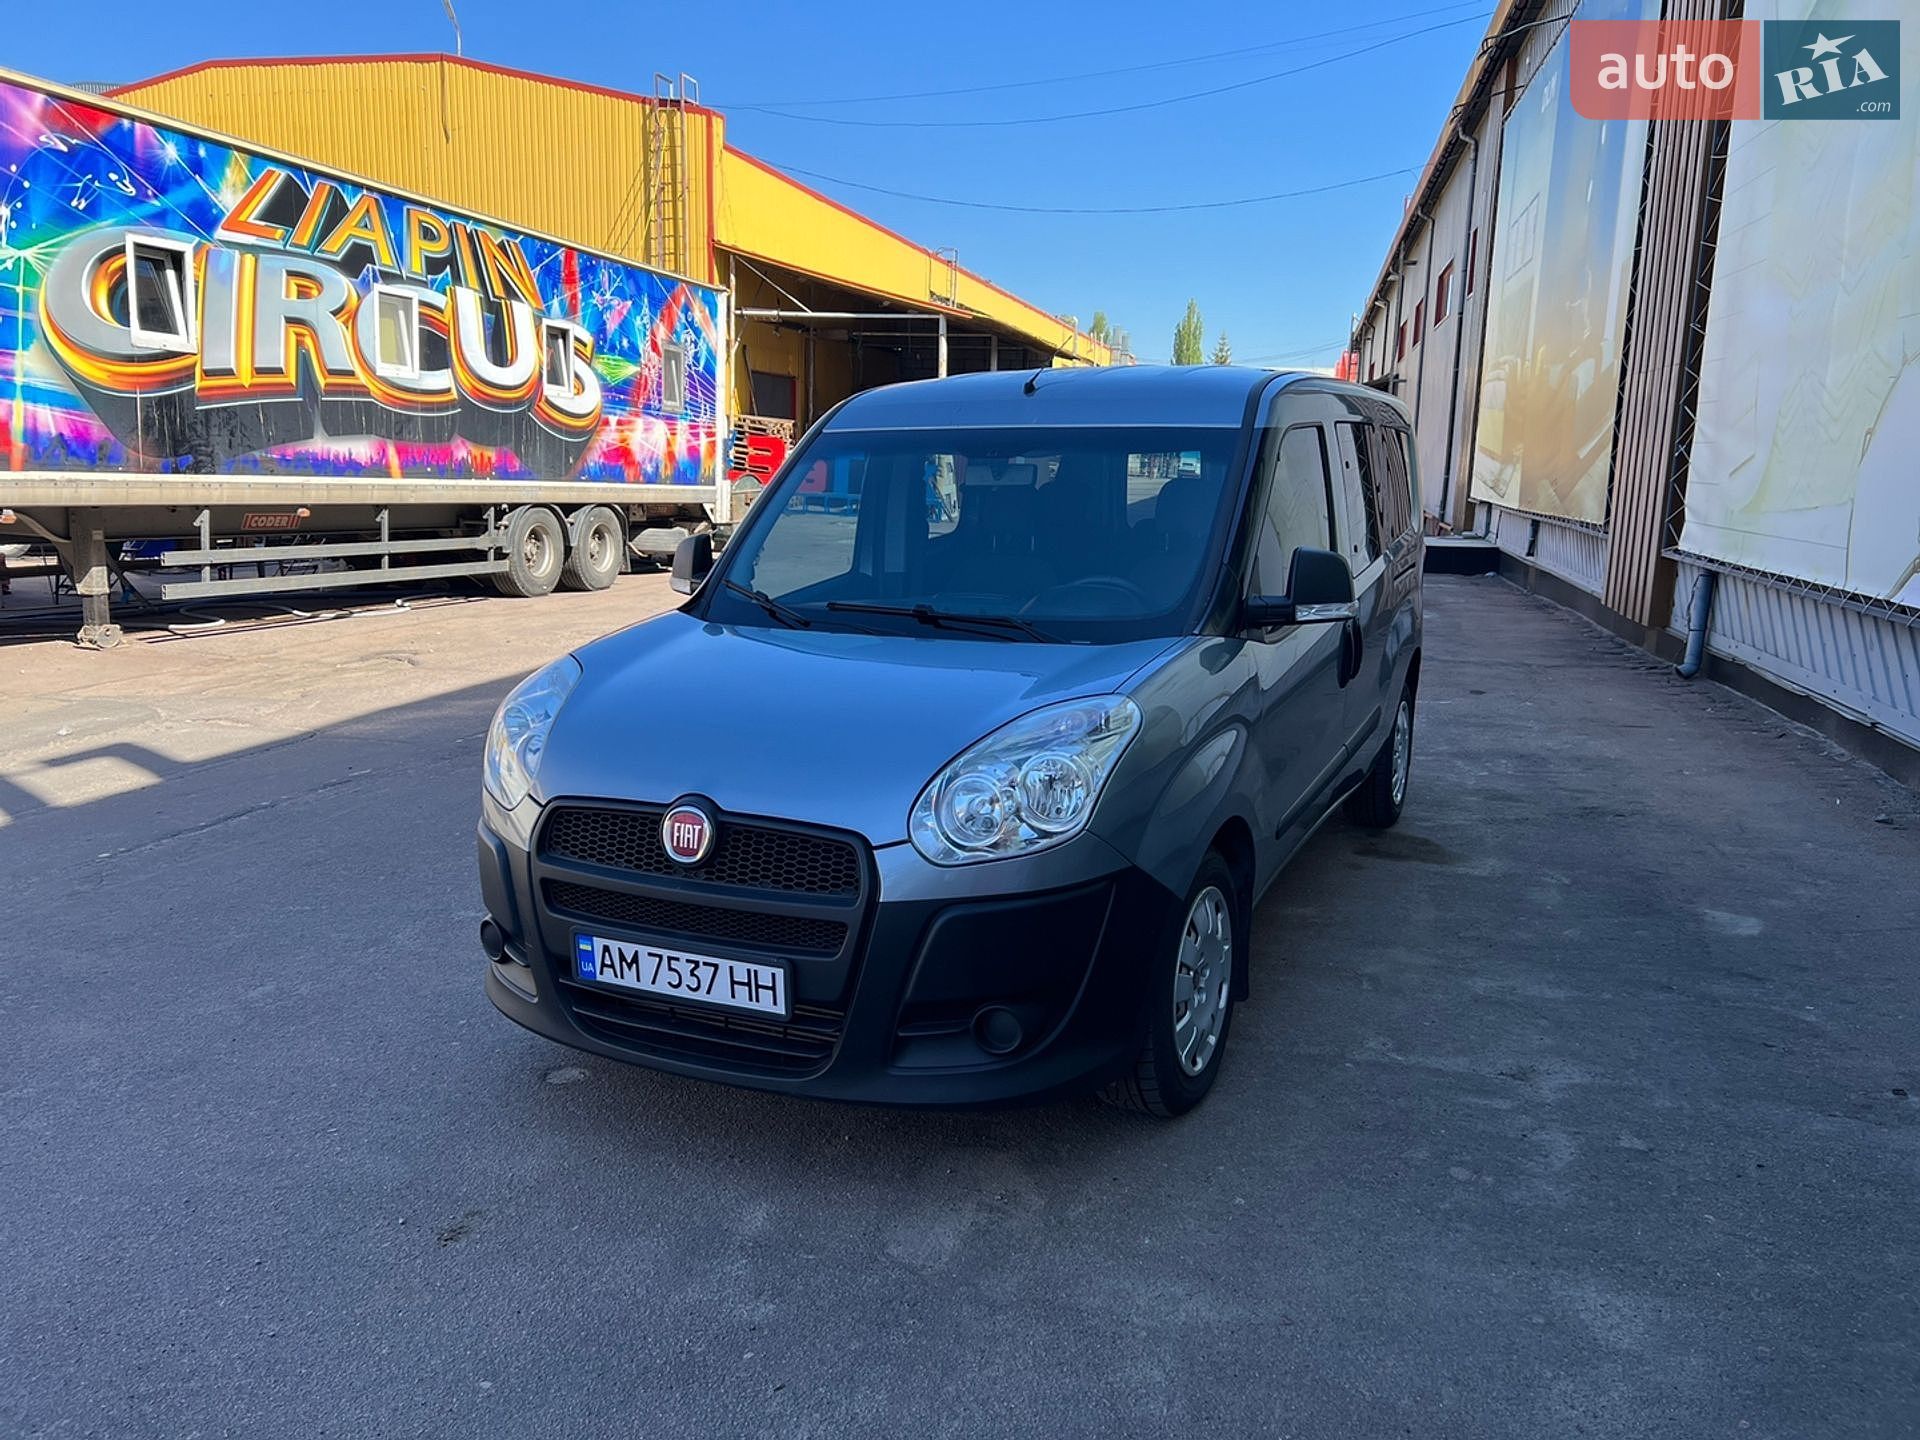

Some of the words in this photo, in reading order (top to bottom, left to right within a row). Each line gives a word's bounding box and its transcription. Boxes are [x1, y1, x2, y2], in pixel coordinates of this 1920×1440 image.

[217, 166, 544, 309] LIAPIN
[39, 226, 603, 432] CIRCUS
[250, 515, 289, 527] CODER
[673, 822, 702, 849] FIAT
[581, 960, 594, 973] UA
[599, 944, 641, 982] AM
[647, 951, 719, 995] 7537
[729, 965, 778, 1006] HH
